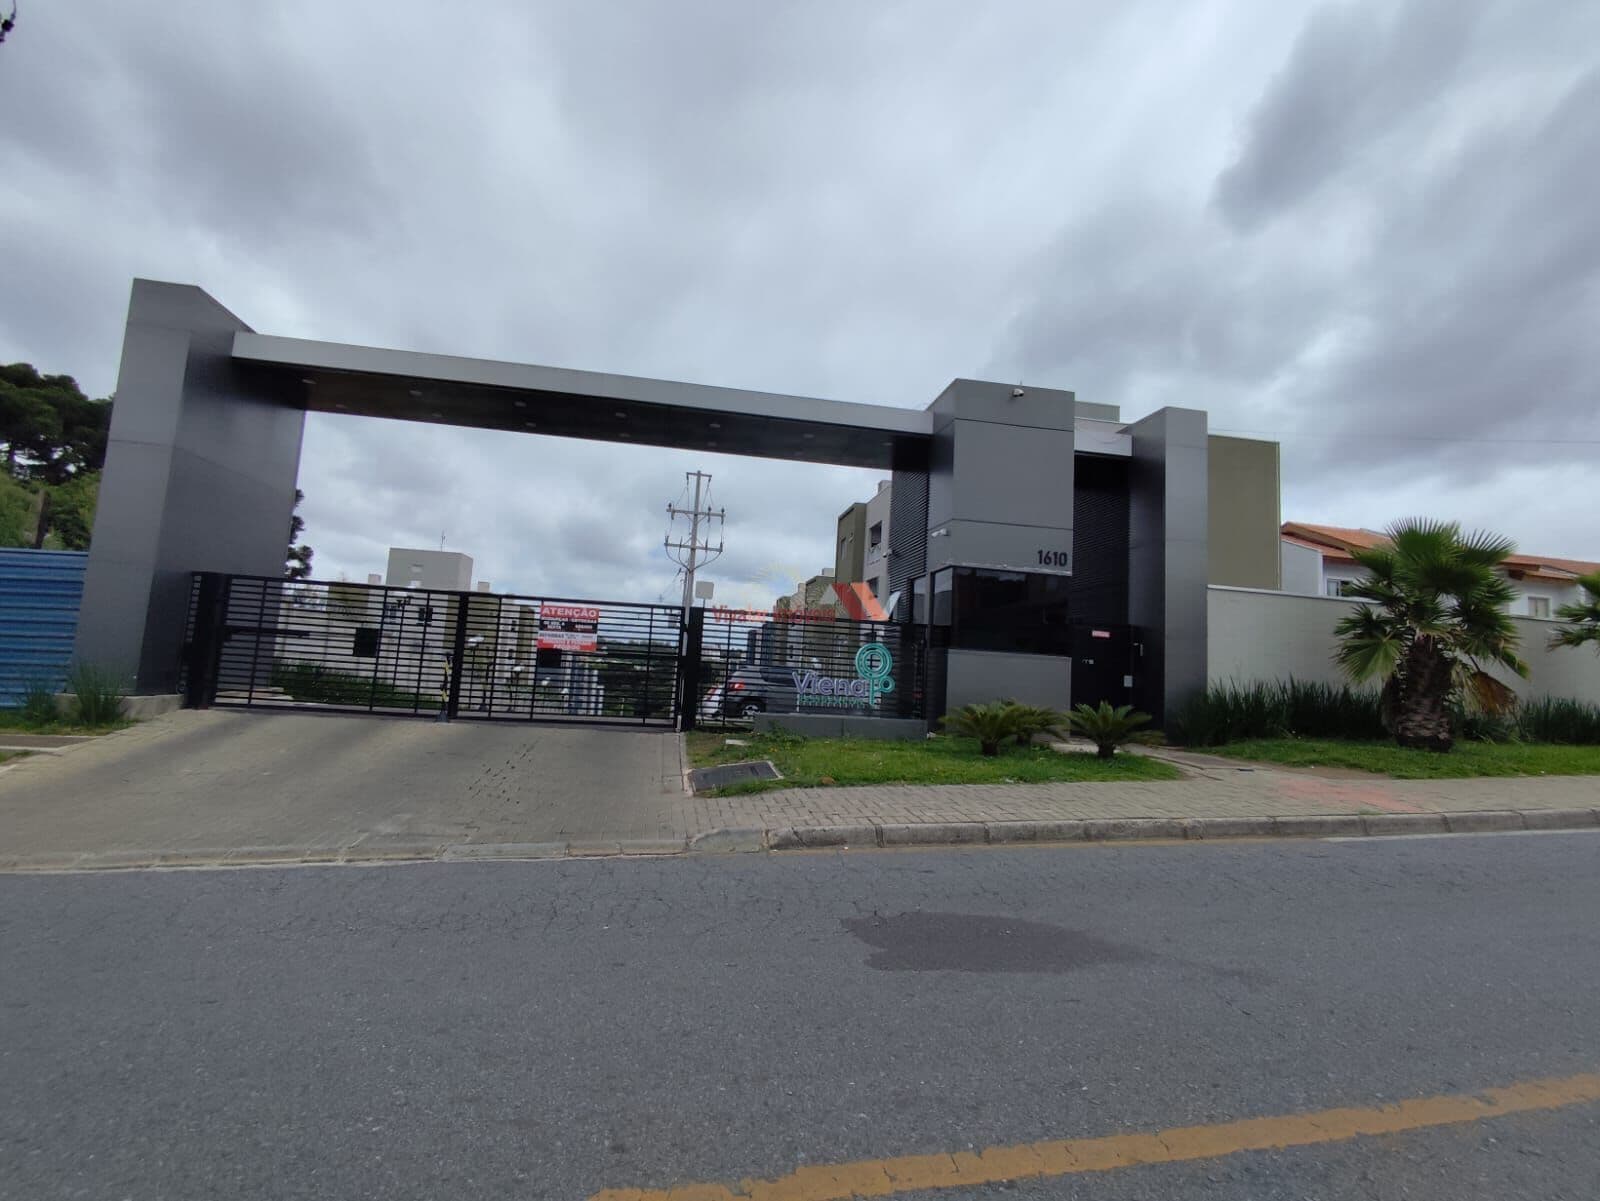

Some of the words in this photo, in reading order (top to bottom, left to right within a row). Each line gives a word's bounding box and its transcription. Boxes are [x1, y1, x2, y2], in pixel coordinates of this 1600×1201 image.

[1037, 550, 1068, 567] 1610
[541, 606, 598, 618] ATENÇÃO
[792, 671, 867, 697] Viena
